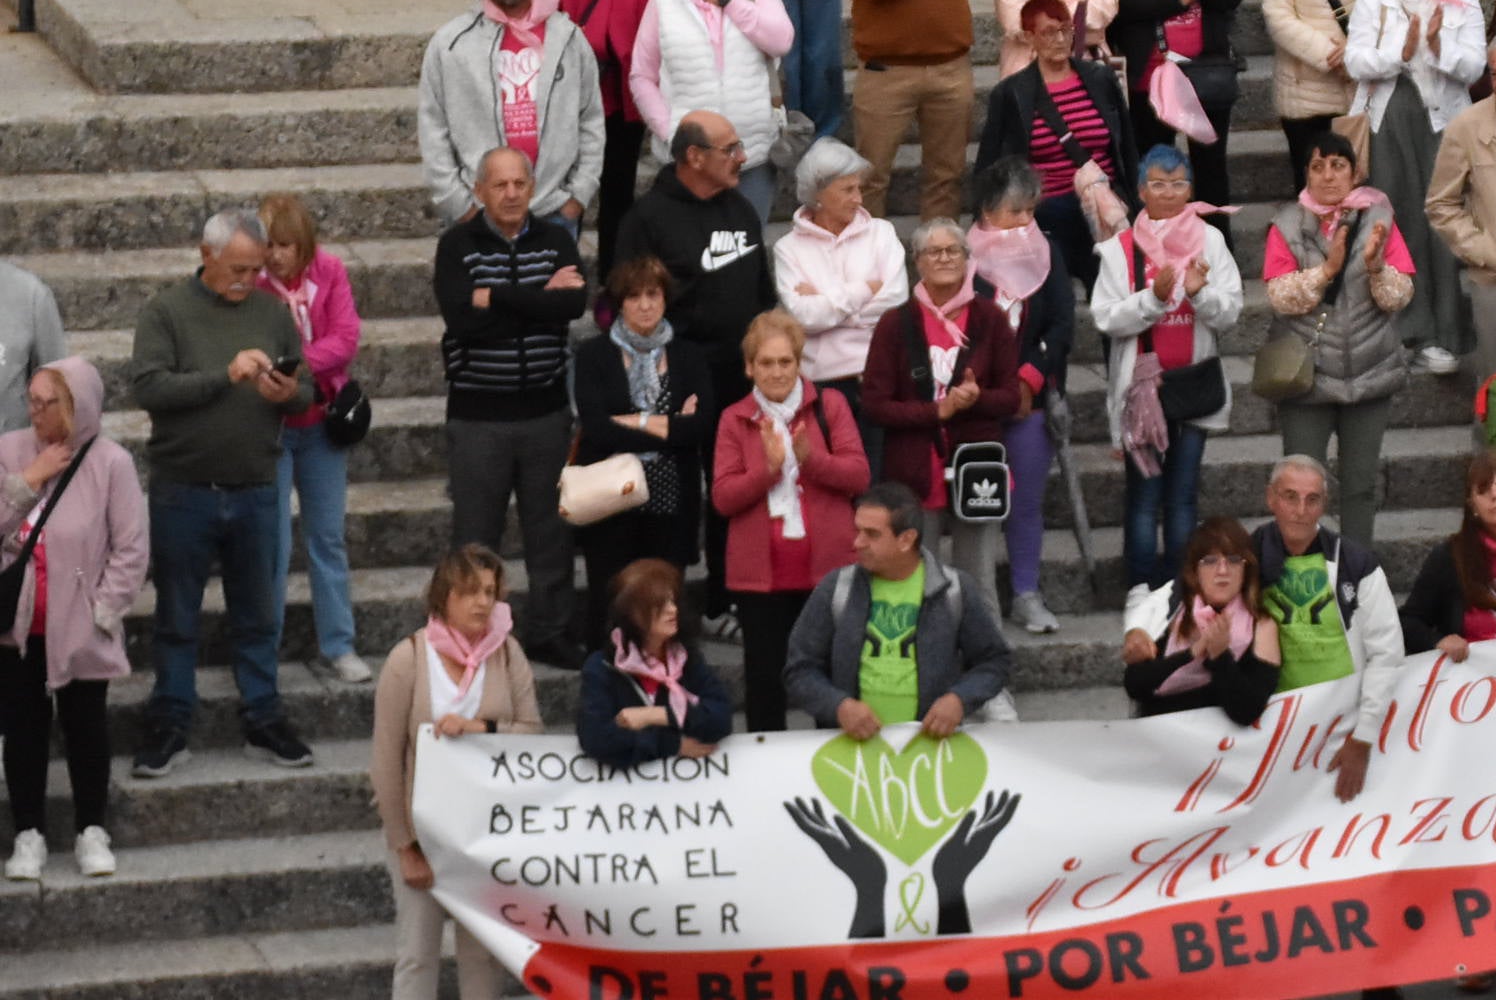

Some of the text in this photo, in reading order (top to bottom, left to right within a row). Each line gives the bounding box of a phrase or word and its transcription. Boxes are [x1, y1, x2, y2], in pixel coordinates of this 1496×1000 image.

[710, 230, 748, 254] NIKE
[488, 798, 734, 836] BEJARANA
[490, 847, 738, 887] CONTRA EL
[500, 901, 740, 937] CÁNCER
[1002, 930, 1151, 999] POR
[1171, 898, 1379, 974] BÉJAR
